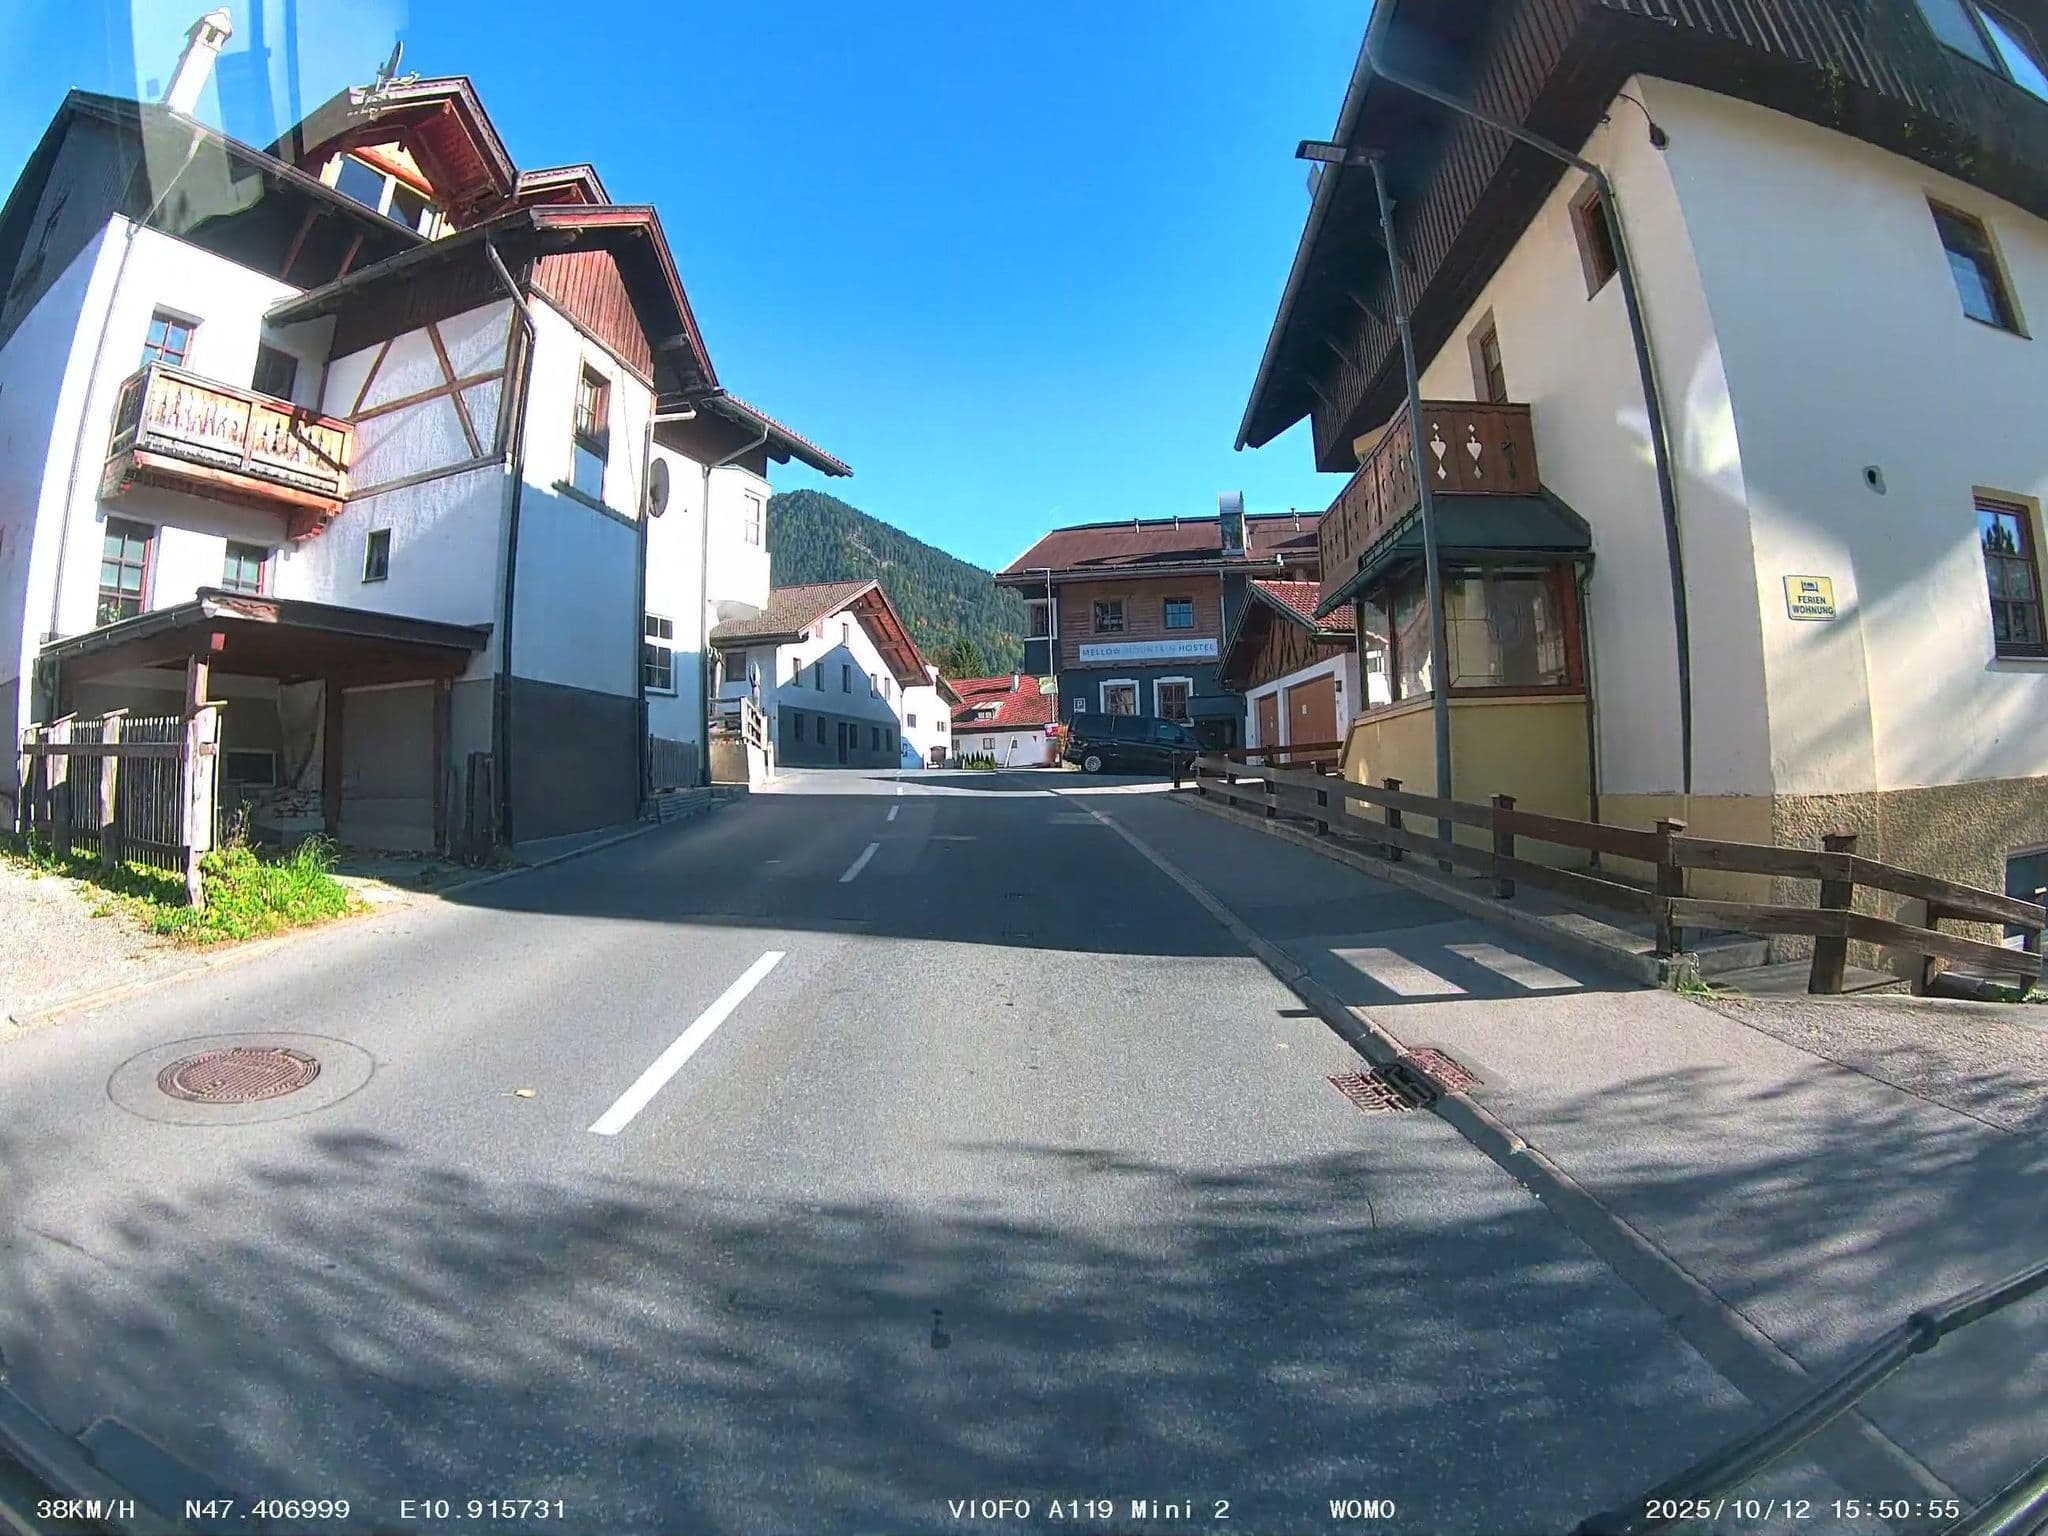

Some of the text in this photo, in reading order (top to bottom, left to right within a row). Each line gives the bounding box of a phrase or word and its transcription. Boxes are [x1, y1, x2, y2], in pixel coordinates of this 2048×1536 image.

[1797, 595, 1826, 605] FERIEN
[1792, 604, 1834, 615] WOHNUNG
[1081, 647, 1121, 657] MELLOW
[1178, 643, 1214, 652] HOSTEL
